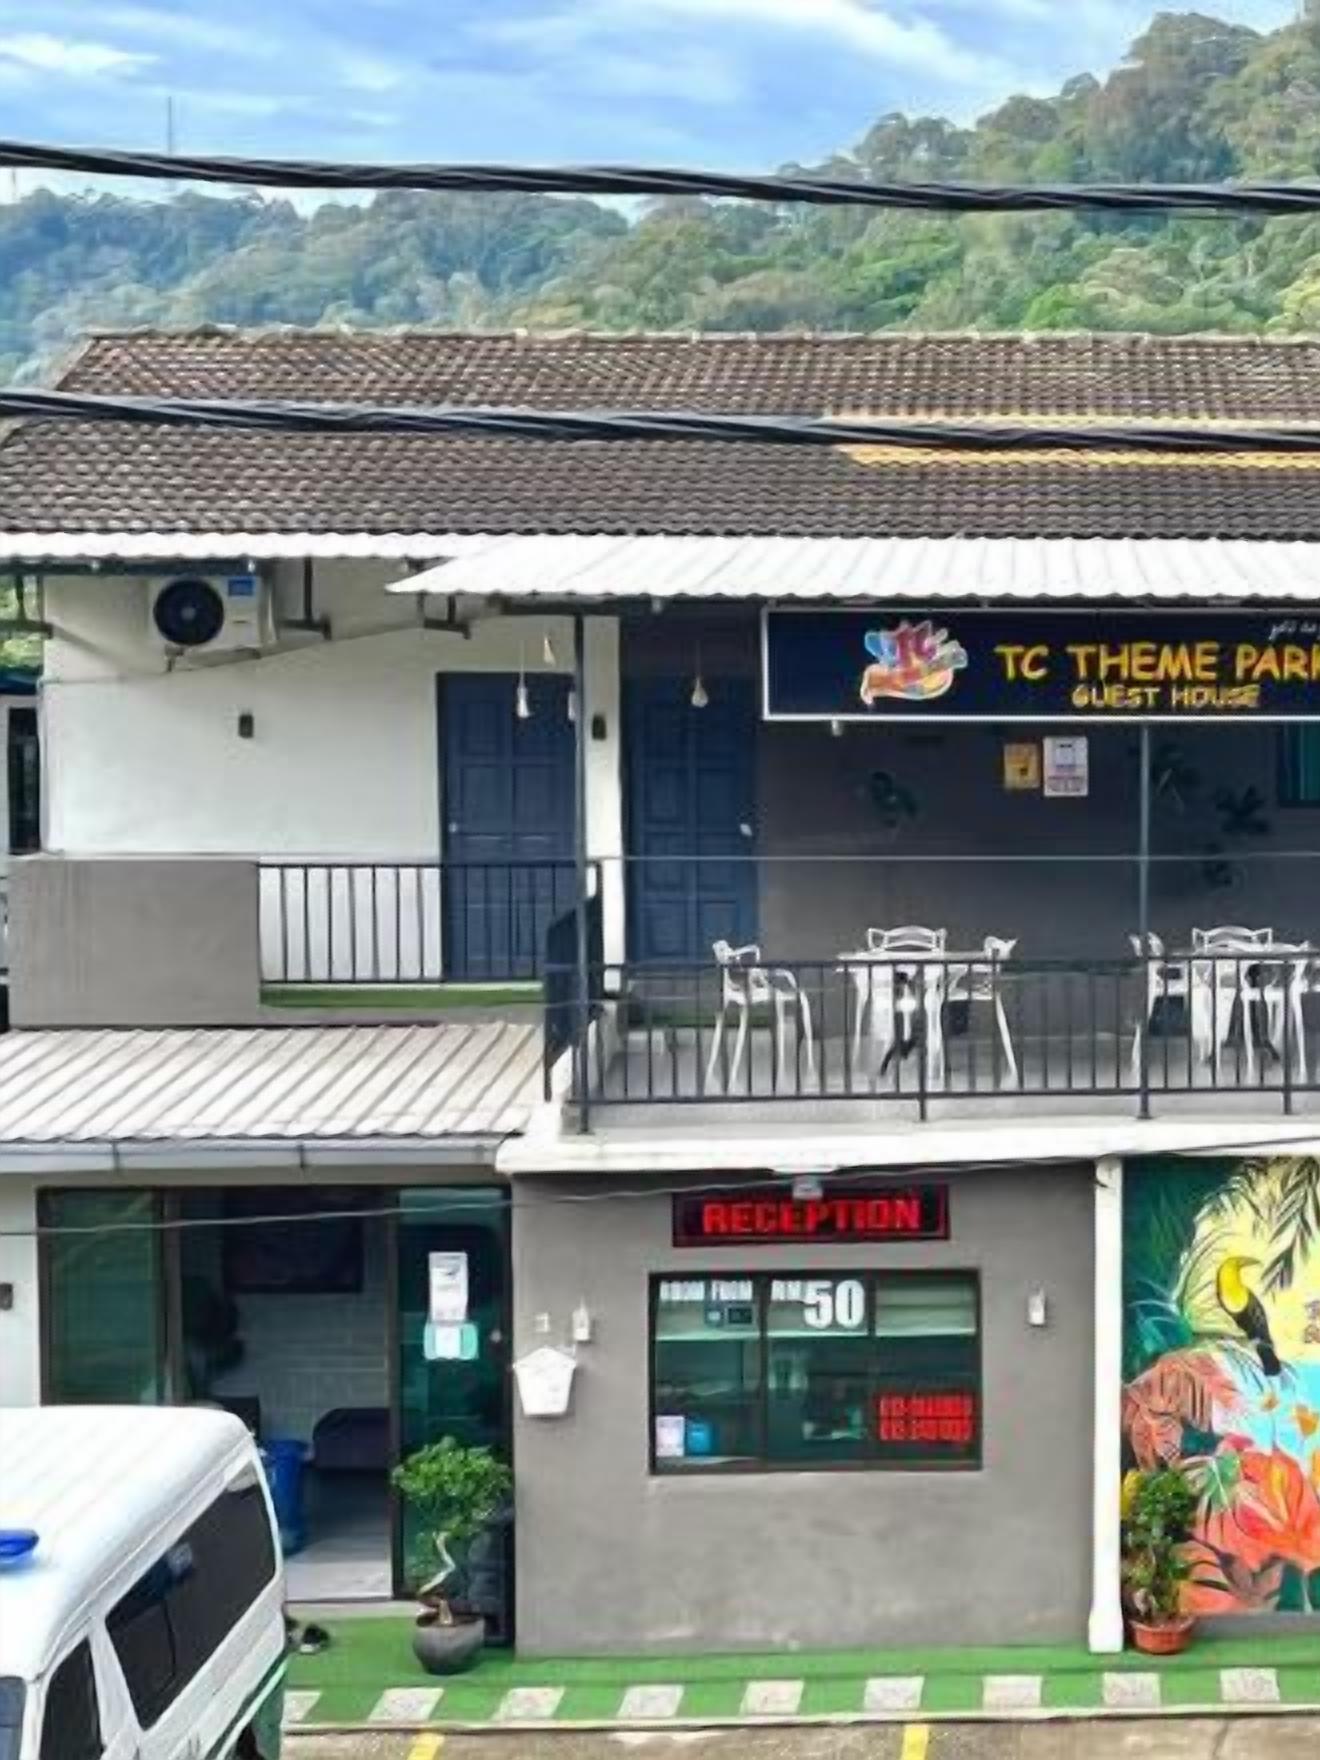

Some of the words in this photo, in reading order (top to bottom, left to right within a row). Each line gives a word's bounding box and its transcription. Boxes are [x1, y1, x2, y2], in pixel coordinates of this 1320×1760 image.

[994, 645, 1048, 680] TC
[1066, 642, 1220, 681] THEME
[1071, 684, 1161, 708] GUEST
[1171, 684, 1261, 708] HOUSE
[703, 1197, 921, 1235] RECEPTION
